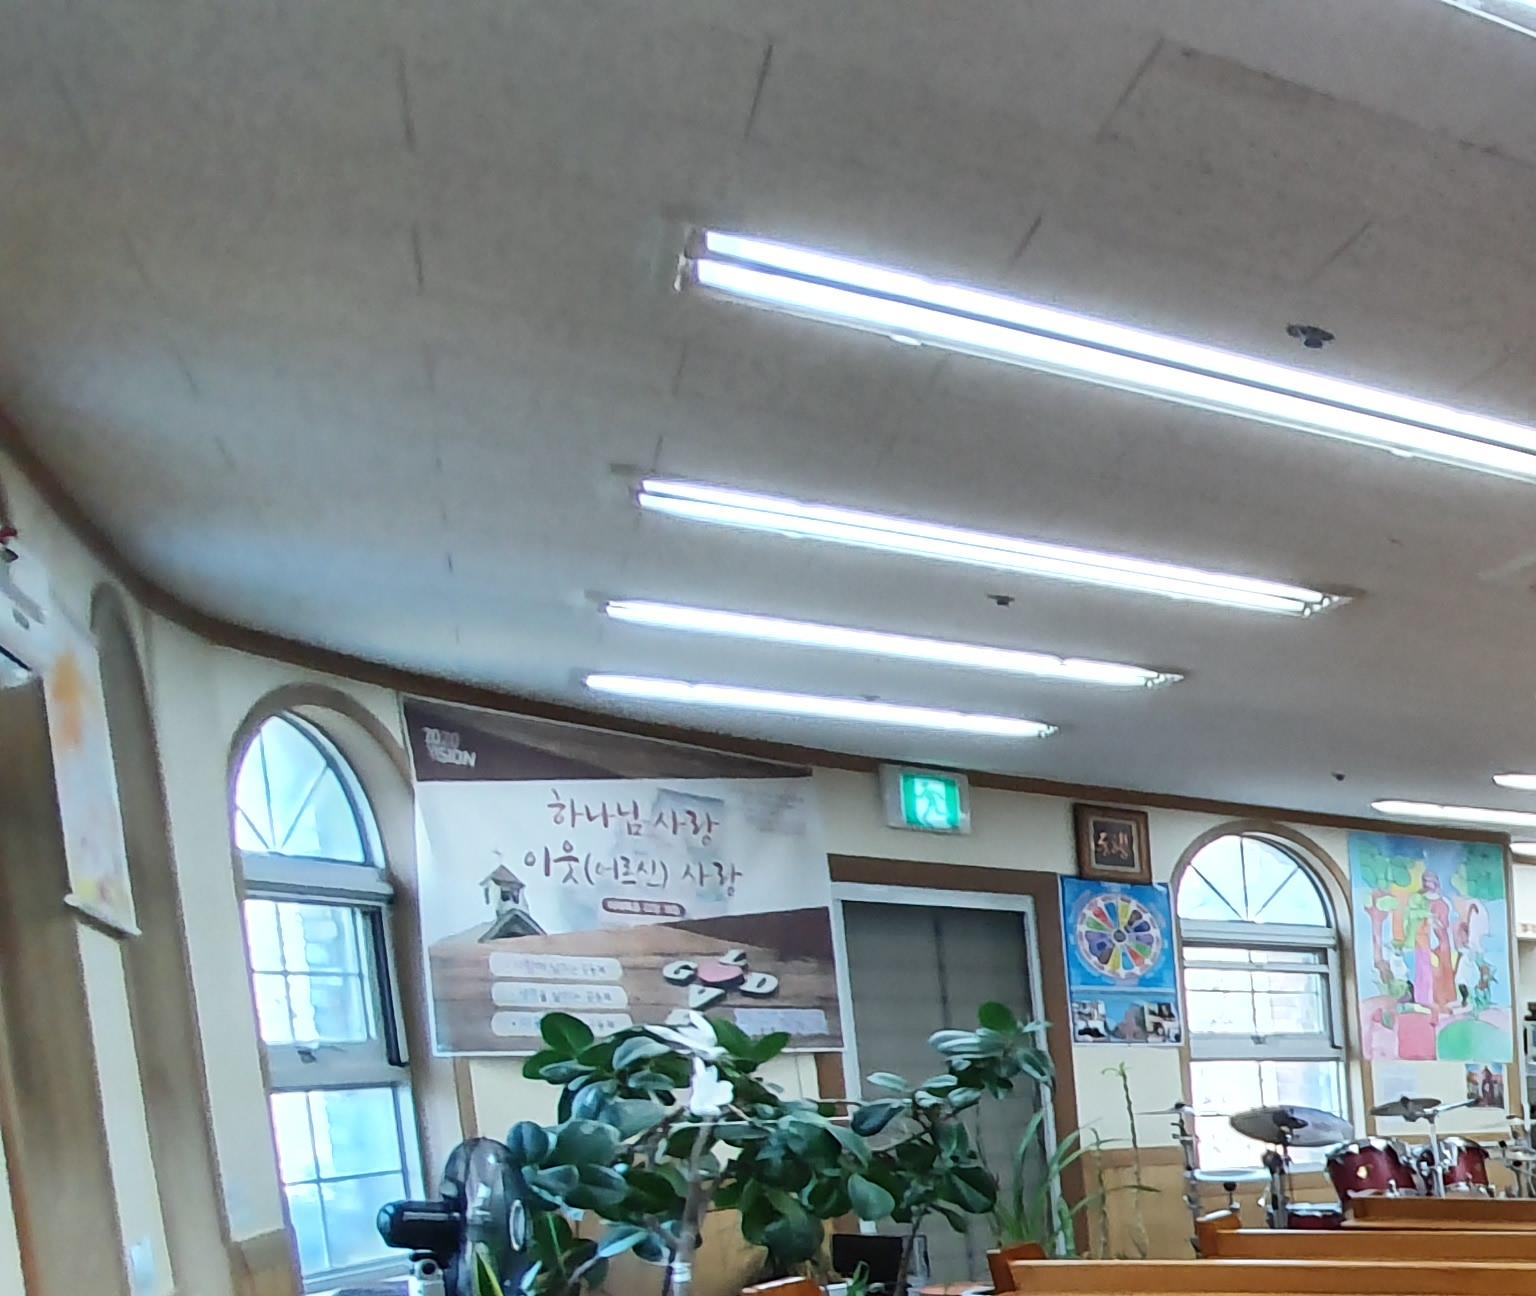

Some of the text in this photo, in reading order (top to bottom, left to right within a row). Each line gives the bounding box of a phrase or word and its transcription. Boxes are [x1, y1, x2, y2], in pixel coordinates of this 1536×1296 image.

[547, 787, 642, 836] 하나님
[653, 809, 720, 847] 사랑
[524, 839, 744, 897] 이웃(어르신) 사랑
